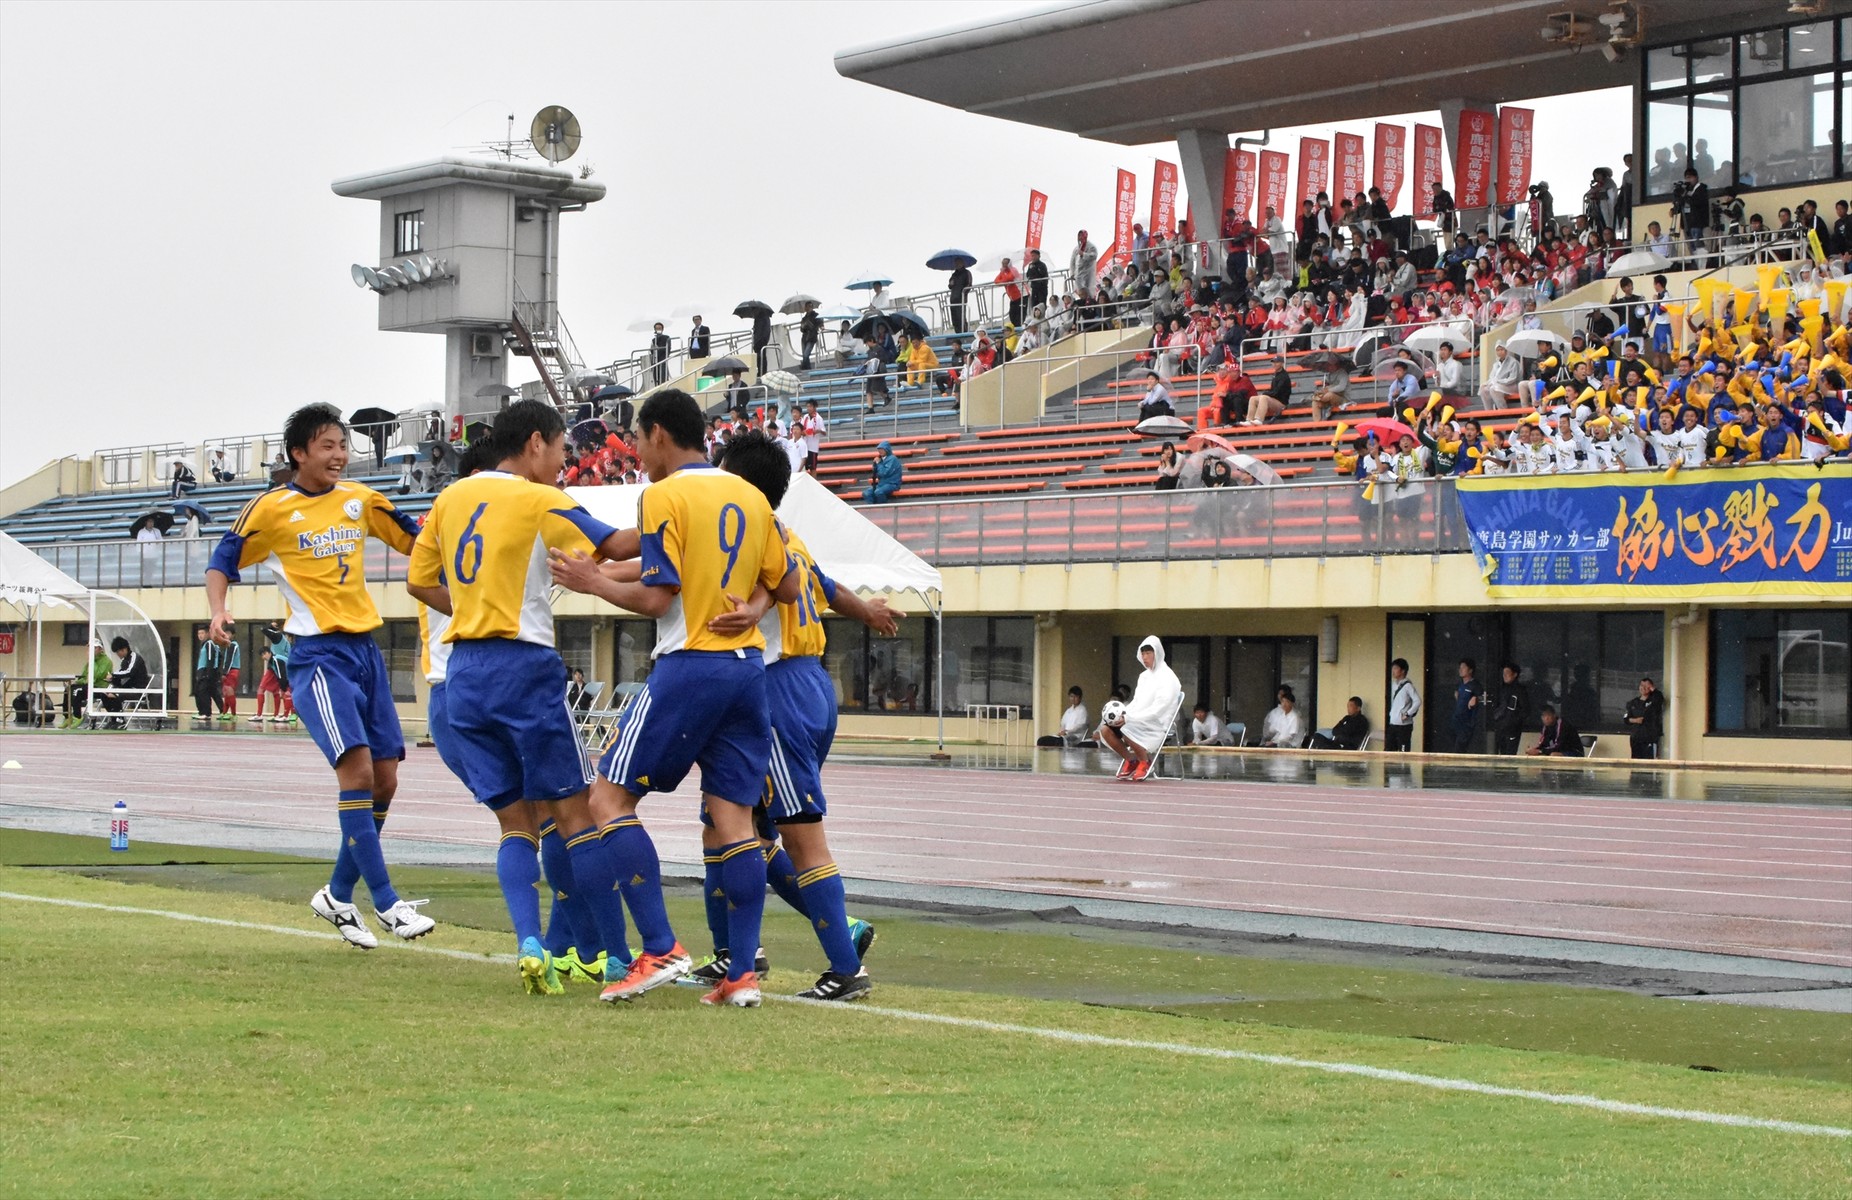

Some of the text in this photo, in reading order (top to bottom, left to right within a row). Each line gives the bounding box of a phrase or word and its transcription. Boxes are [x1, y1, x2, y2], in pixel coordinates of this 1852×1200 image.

[1465, 133, 1484, 205] 鹿島高等学校
[1506, 129, 1523, 201] 鹿島高等学校
[297, 524, 363, 550] Kashima
[338, 553, 349, 585] 5
[454, 502, 489, 584] 6
[718, 503, 746, 589] 9
